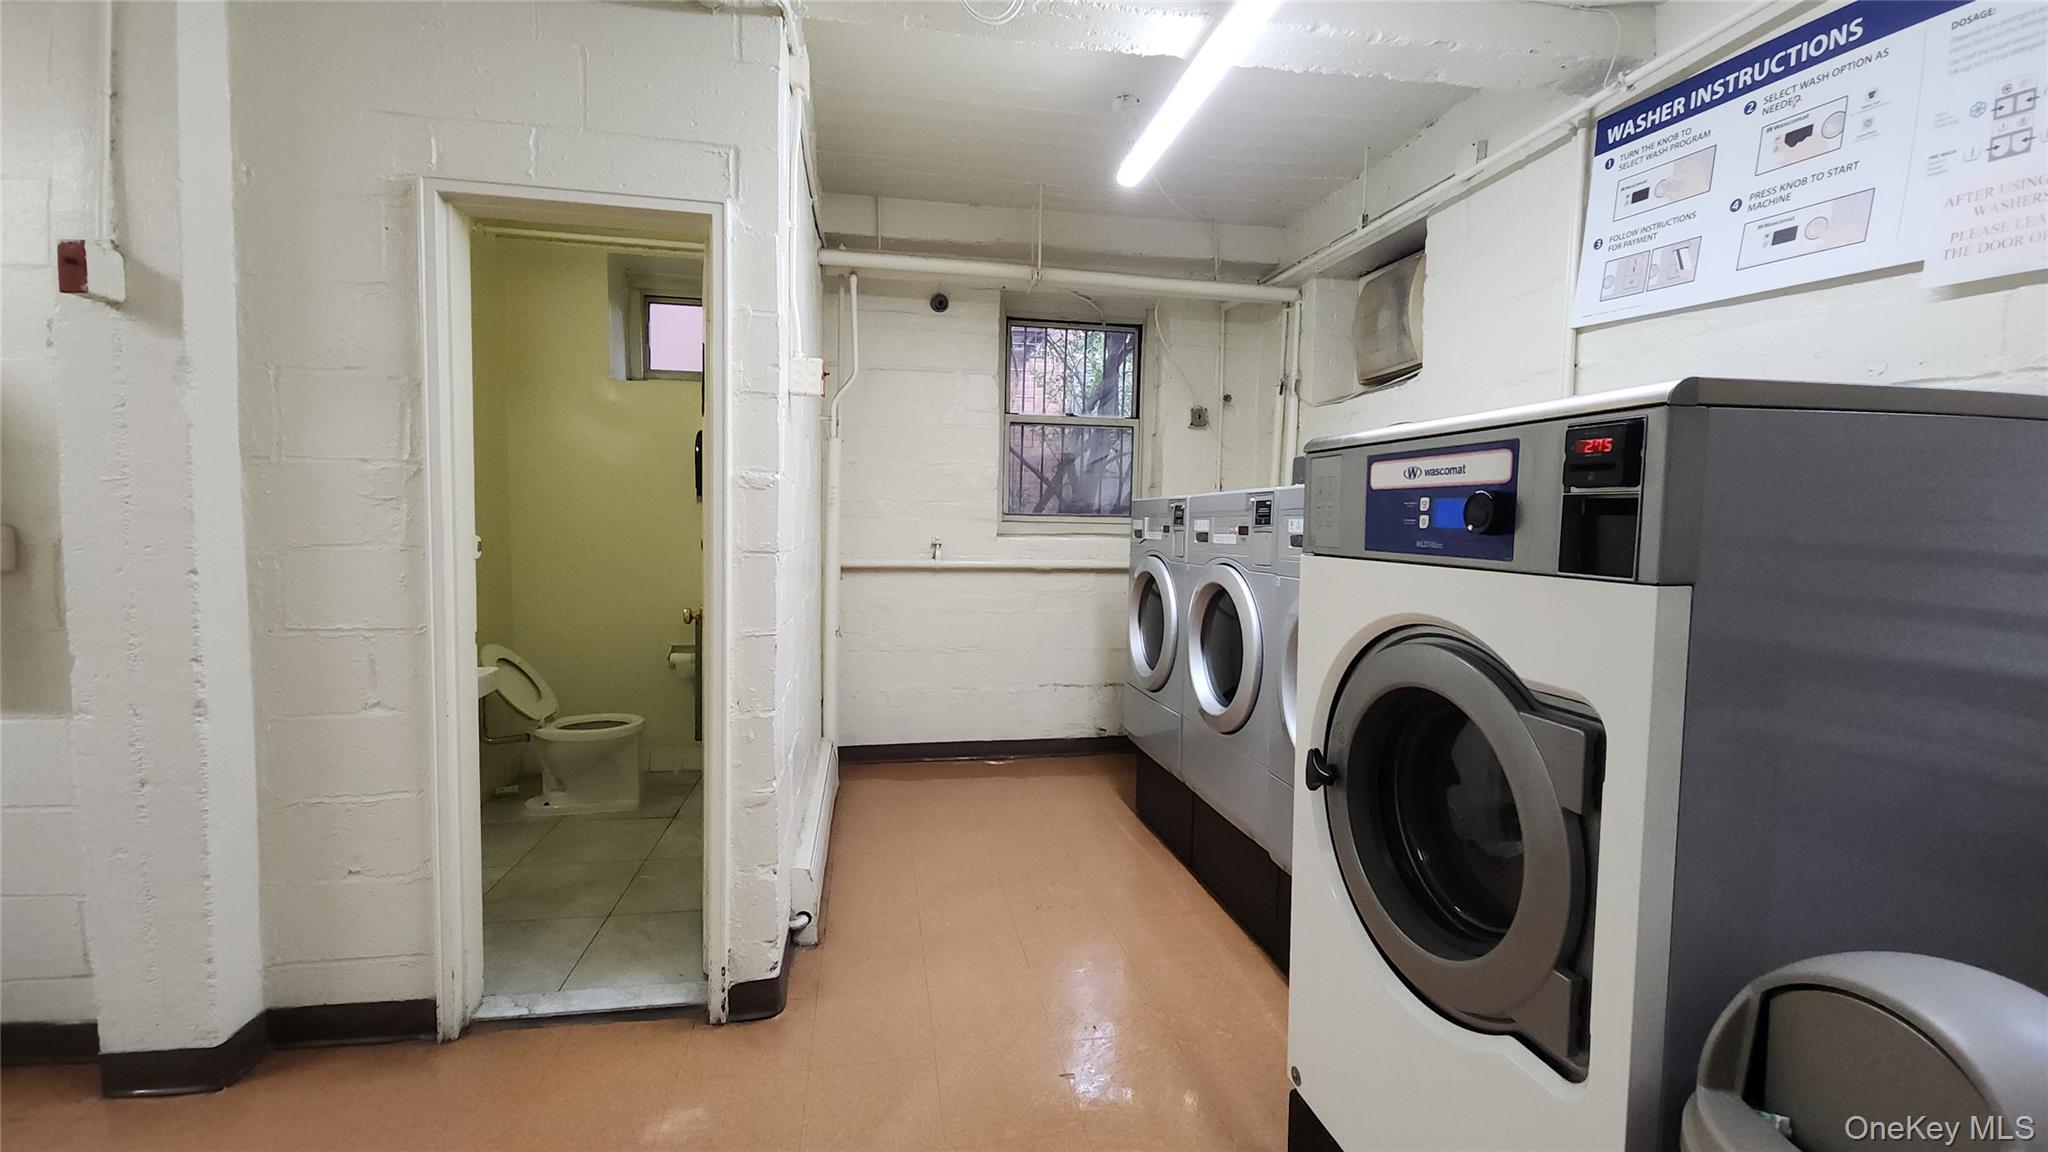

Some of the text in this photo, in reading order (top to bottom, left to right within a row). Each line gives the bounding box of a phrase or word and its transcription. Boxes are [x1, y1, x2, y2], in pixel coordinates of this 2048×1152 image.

[1951, 7, 1997, 30] DOSAGE:
[1607, 17, 1863, 144] WASHER INSTRUCTIONS
[1763, 84, 1798, 105] SELECT
[1799, 73, 1830, 91] WASH
[1832, 54, 1873, 78] OPTION
[1875, 48, 1890, 61] AS
[1619, 129, 1711, 171] SELECT WASH PROGRAM
[1620, 149, 1640, 160] TURN
[1641, 143, 1654, 154] THE
[1656, 134, 1679, 147] KNOB
[1681, 127, 1692, 137] TO
[1749, 186, 1777, 201] PRESS
[1779, 176, 1808, 193] KNOB
[1810, 171, 1825, 184] TO
[1827, 160, 1860, 179] START
[1747, 192, 1792, 213] MACHINE
[1944, 186, 1994, 208] AFTER
[1609, 228, 1639, 243] FOLLOW
[1640, 210, 1697, 233] INSTRUCTIONS
[1950, 220, 2010, 243] PLEASE
[1607, 232, 1658, 253] FOR PAYMENT
[1943, 245, 1973, 260] THE
[1977, 234, 2024, 254] DOOR
[1424, 463, 1466, 477] wascomat
